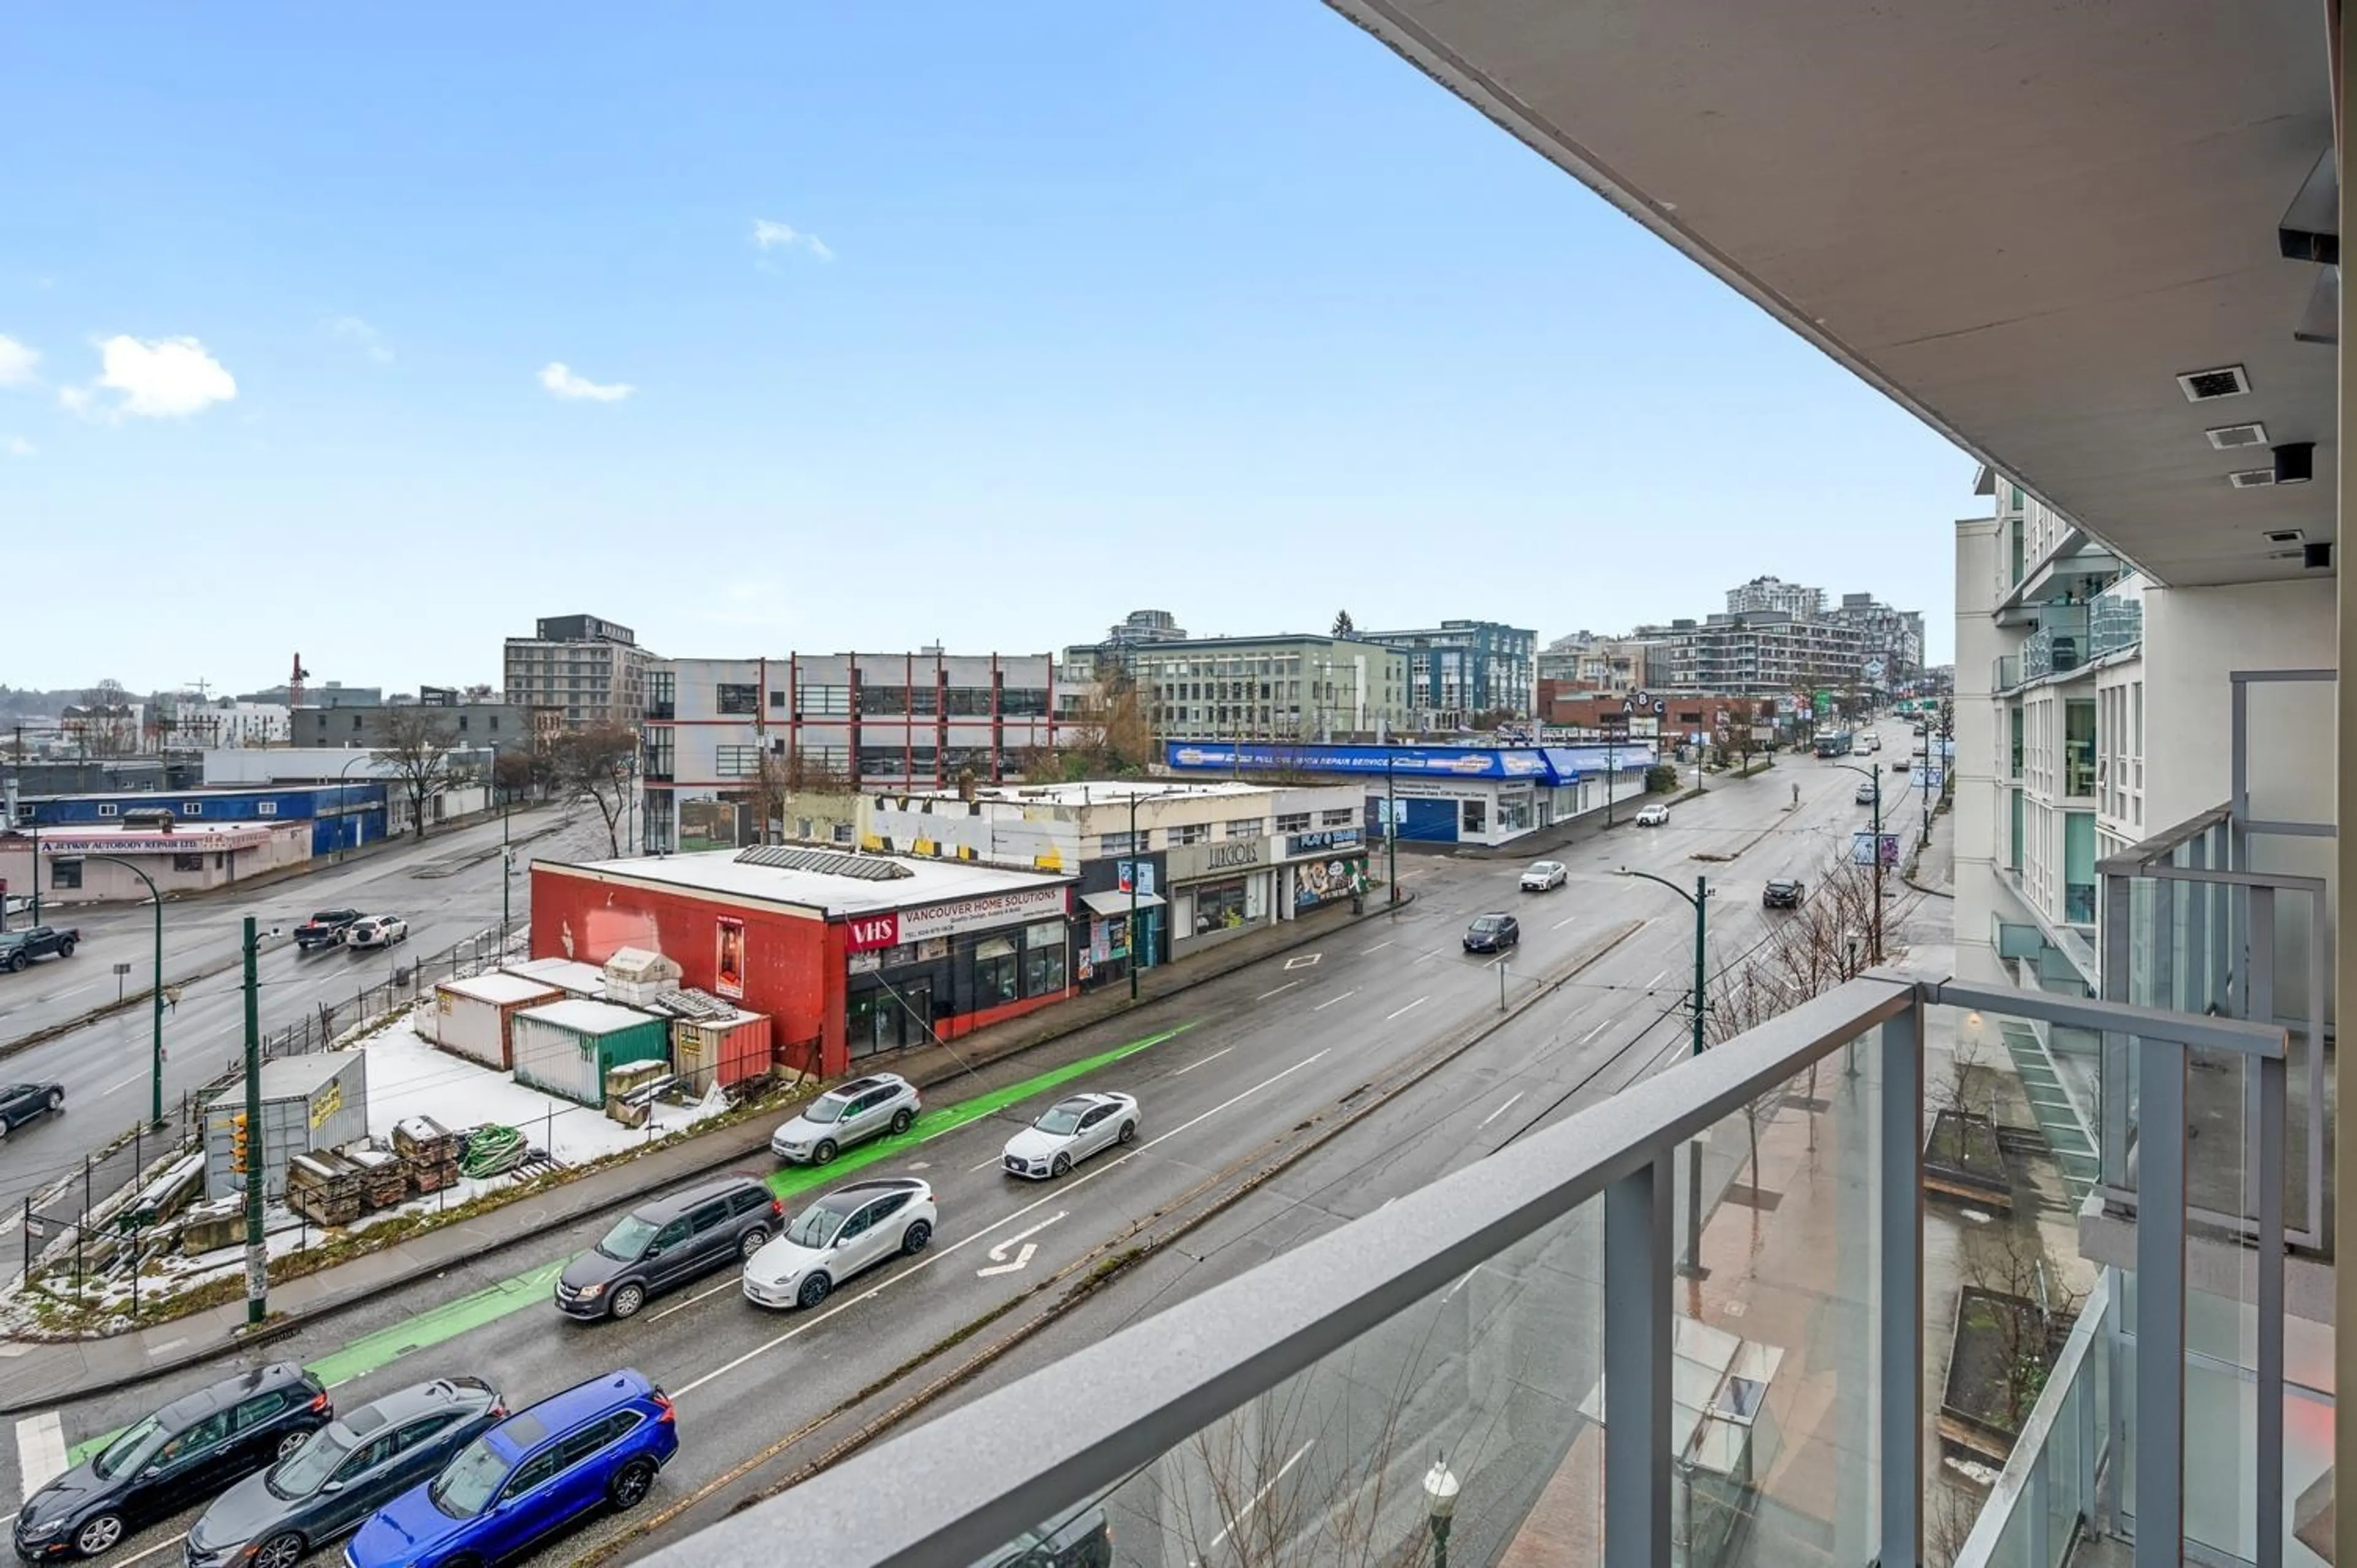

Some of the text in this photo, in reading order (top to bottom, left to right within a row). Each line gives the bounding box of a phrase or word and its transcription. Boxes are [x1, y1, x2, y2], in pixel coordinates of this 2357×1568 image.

[1624, 695, 1662, 712] A B C
[42, 843, 52, 851] A
[92, 841, 141, 849] AUTOBODY
[145, 840, 179, 848] REPAIR
[905, 903, 972, 923] VANCOUVER
[973, 898, 1002, 912] HOME
[1005, 888, 1057, 906] SOLUTIONS
[853, 919, 892, 943] VHS
